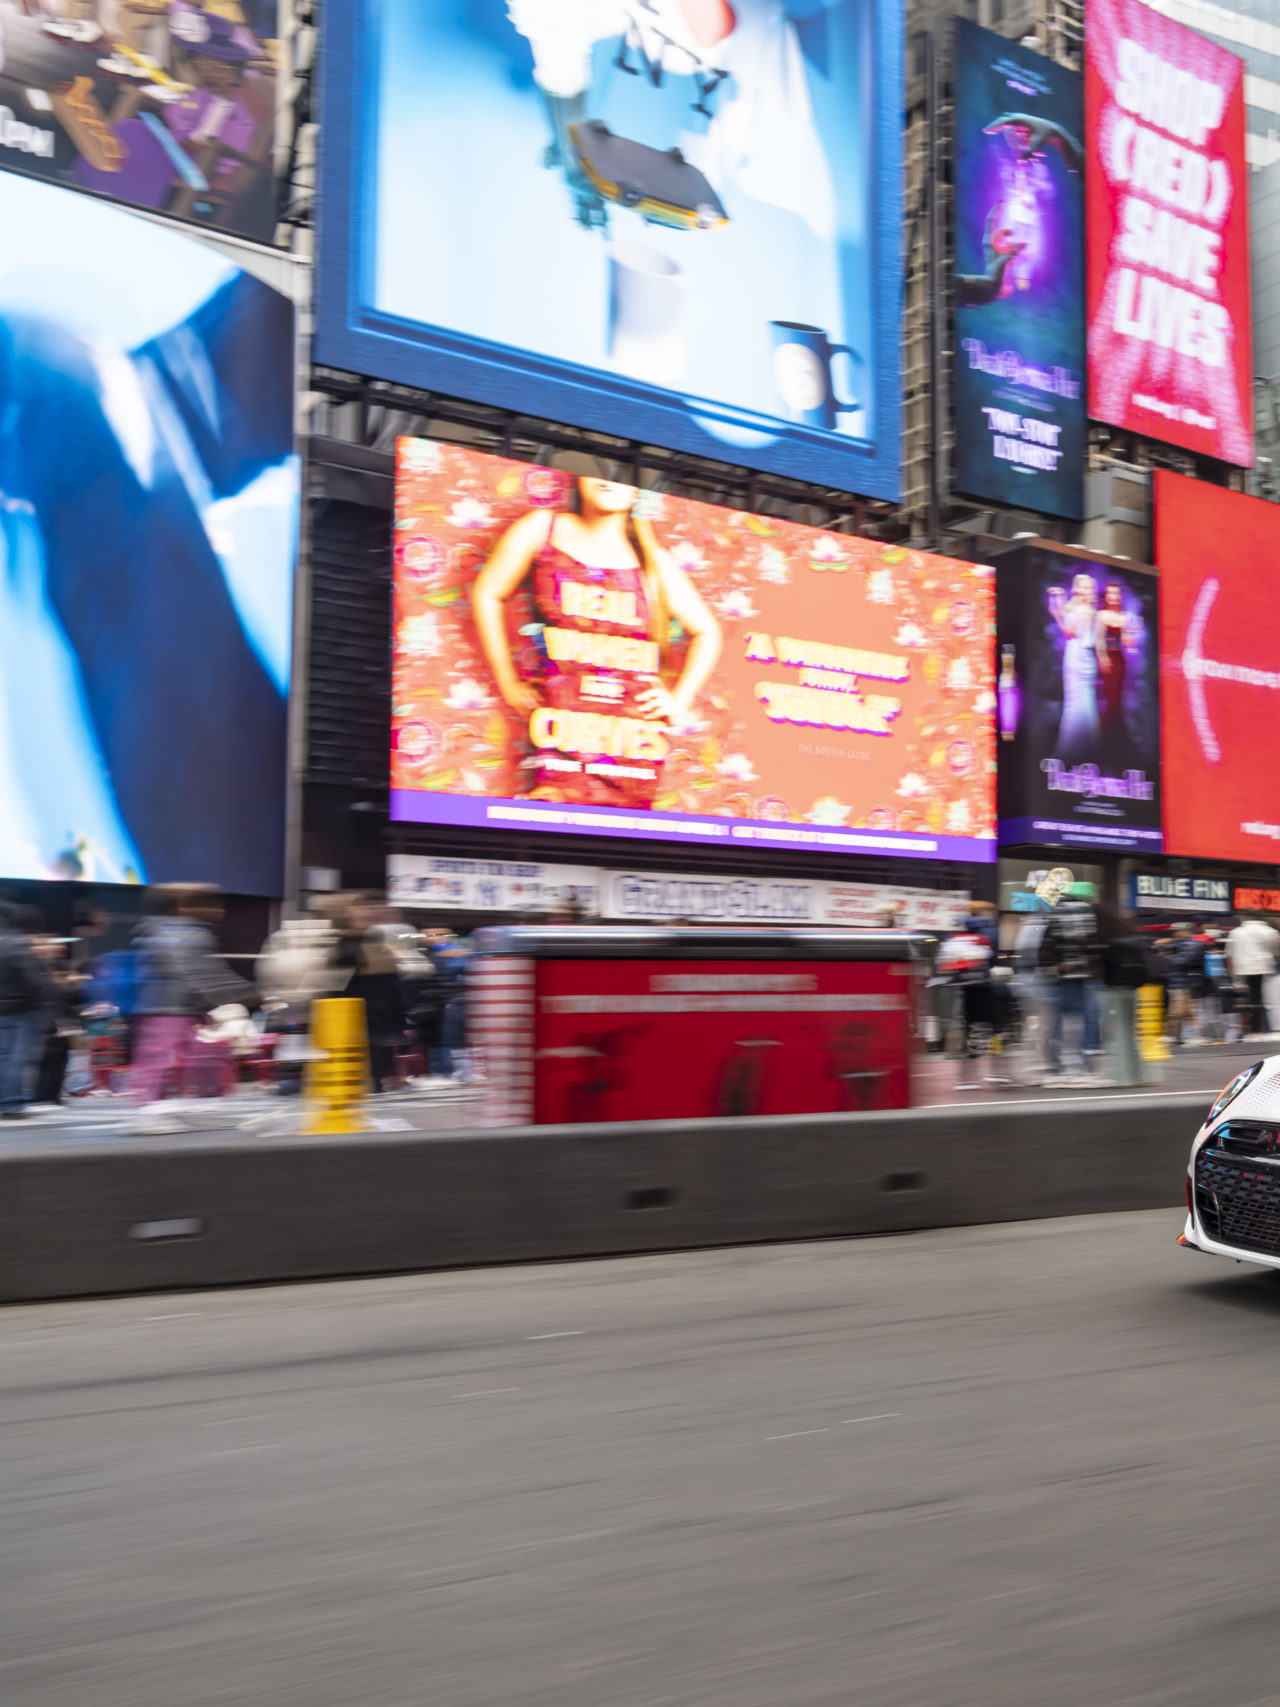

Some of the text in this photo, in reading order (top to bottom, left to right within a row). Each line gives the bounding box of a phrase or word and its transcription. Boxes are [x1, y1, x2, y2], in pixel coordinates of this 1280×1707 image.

[1115, 38, 1223, 146] SHOP
[1120, 200, 1220, 289] SAVE
[1113, 269, 1229, 367] LIVES
[798, 744, 872, 761] THE BOSTON GLOBE
[1136, 875, 1229, 899] BLUE FIN
